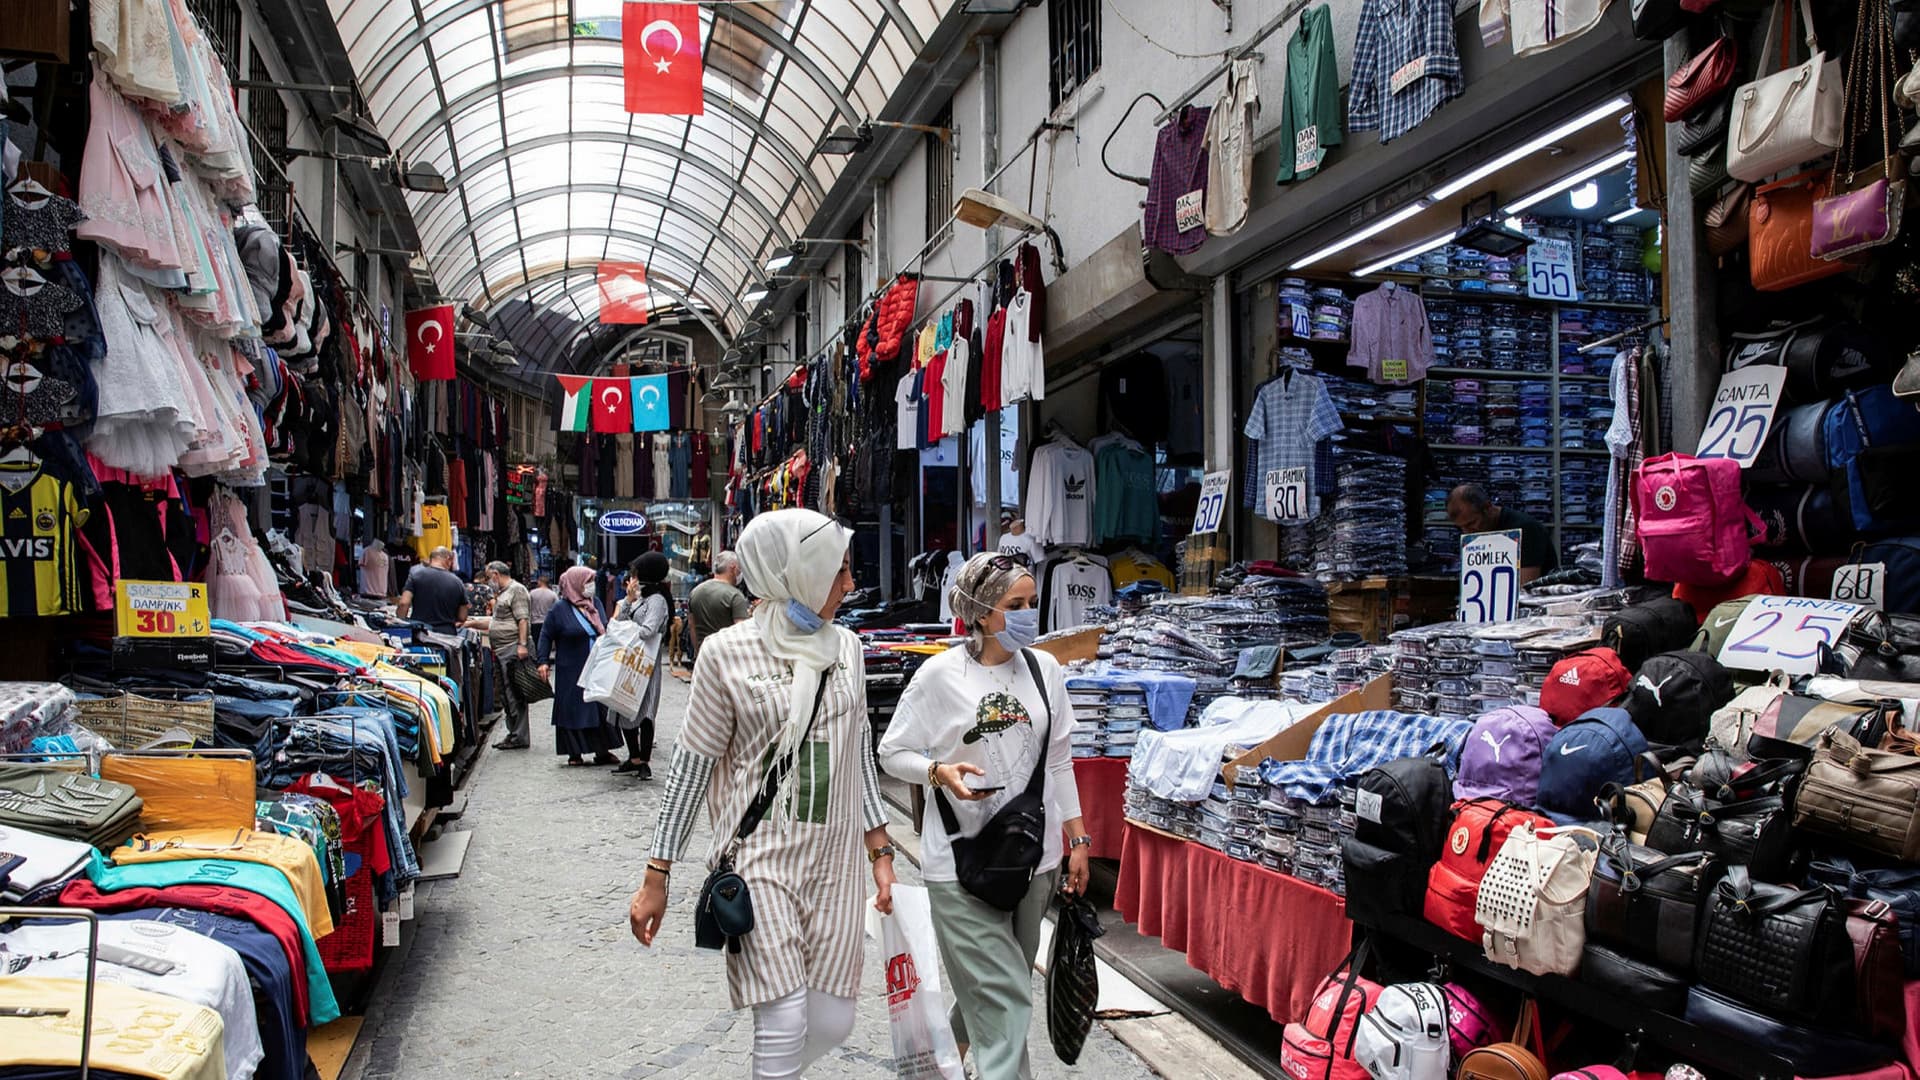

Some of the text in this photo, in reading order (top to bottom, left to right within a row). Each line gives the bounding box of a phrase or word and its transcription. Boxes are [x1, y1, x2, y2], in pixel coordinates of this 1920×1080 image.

[1532, 262, 1570, 298] 55
[1717, 383, 1770, 404] ÇANTA
[1697, 404, 1773, 460] 25
[1195, 494, 1223, 532] 30
[1274, 485, 1298, 520] 30
[1467, 551, 1513, 566] GÖMLEK
[1461, 566, 1515, 622] 30
[1761, 597, 1857, 615] ÇANTA
[137, 610, 176, 633] 30
[1728, 611, 1843, 659] 25
